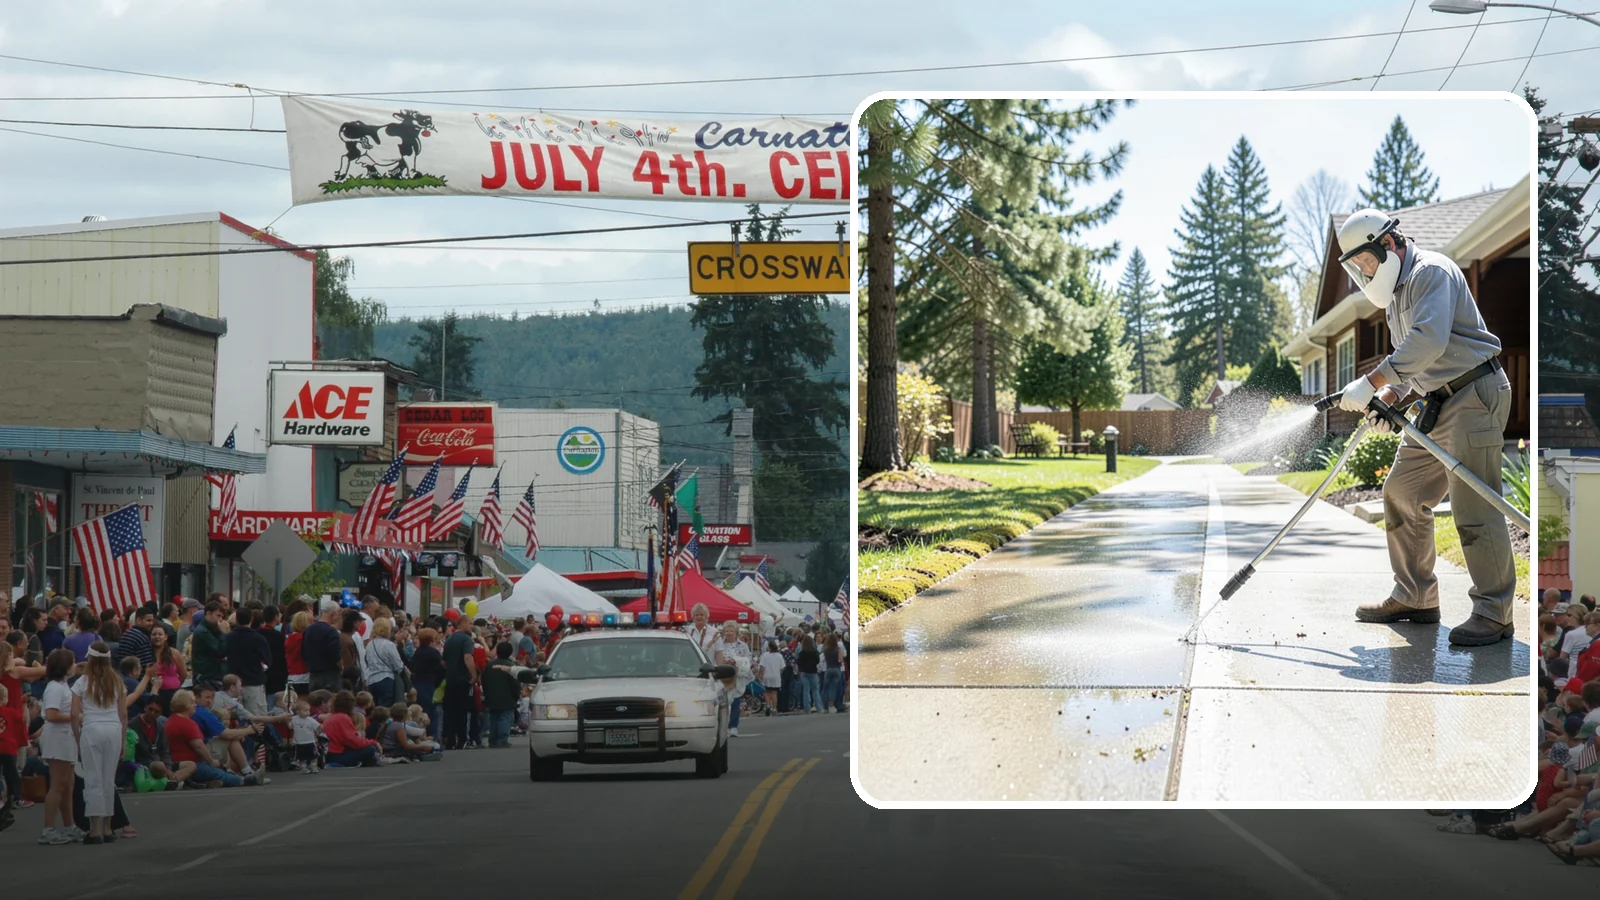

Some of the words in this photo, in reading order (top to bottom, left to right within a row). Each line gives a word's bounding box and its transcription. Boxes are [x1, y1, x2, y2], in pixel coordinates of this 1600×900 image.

[481, 141, 605, 192] JULY
[632, 151, 746, 198] 4th.
[697, 254, 850, 280] CROSSWA
[282, 380, 373, 420] ACE
[406, 410, 453, 422] CEDAR
[283, 421, 371, 437] Hardware
[416, 428, 477, 447] Coca-Cola
[95, 485, 124, 495] Vincent
[126, 486, 136, 495] de
[138, 486, 155, 495] Paul
[688, 526, 742, 535] CRNATION
[699, 535, 730, 543] GLASS
